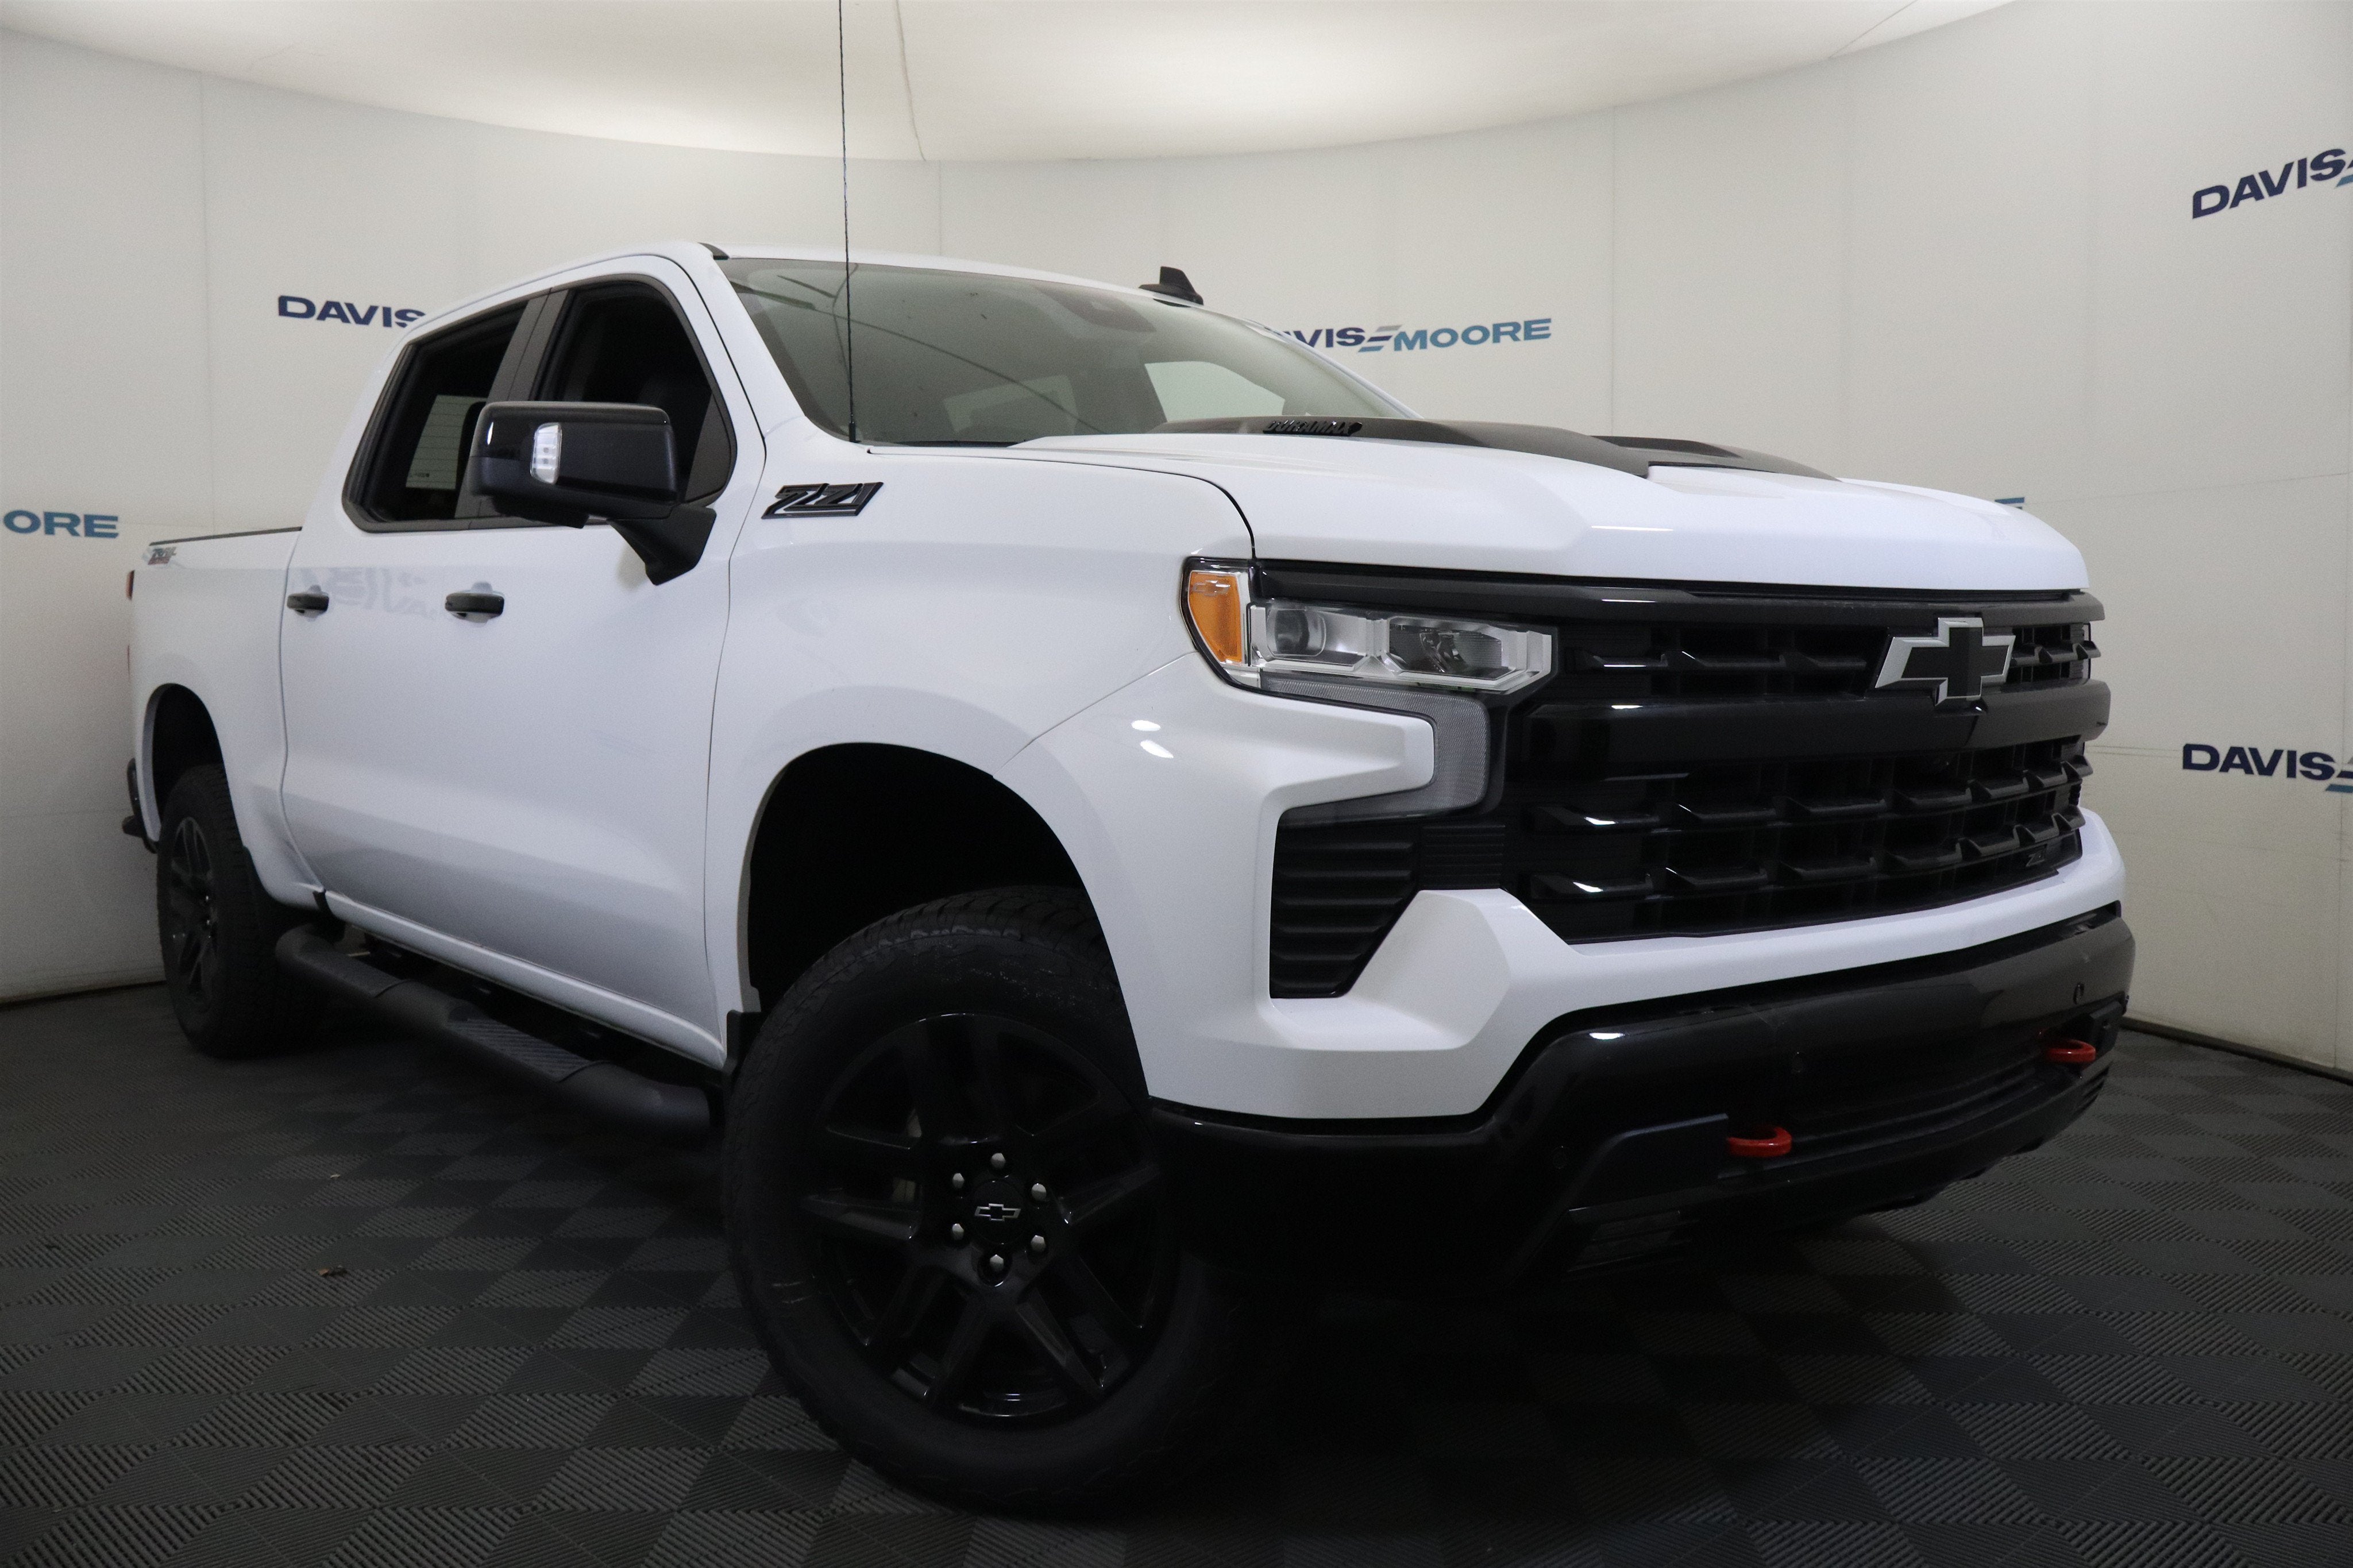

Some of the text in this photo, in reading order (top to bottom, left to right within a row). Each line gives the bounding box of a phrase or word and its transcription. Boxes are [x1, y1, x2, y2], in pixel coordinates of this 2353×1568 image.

[2192, 148, 2346, 219] DAVIS
[278, 295, 426, 328] DAVIS
[1283, 318, 1552, 352] VIS MOORE
[761, 482, 884, 519] Z71
[2182, 743, 2336, 781] DAVIS
